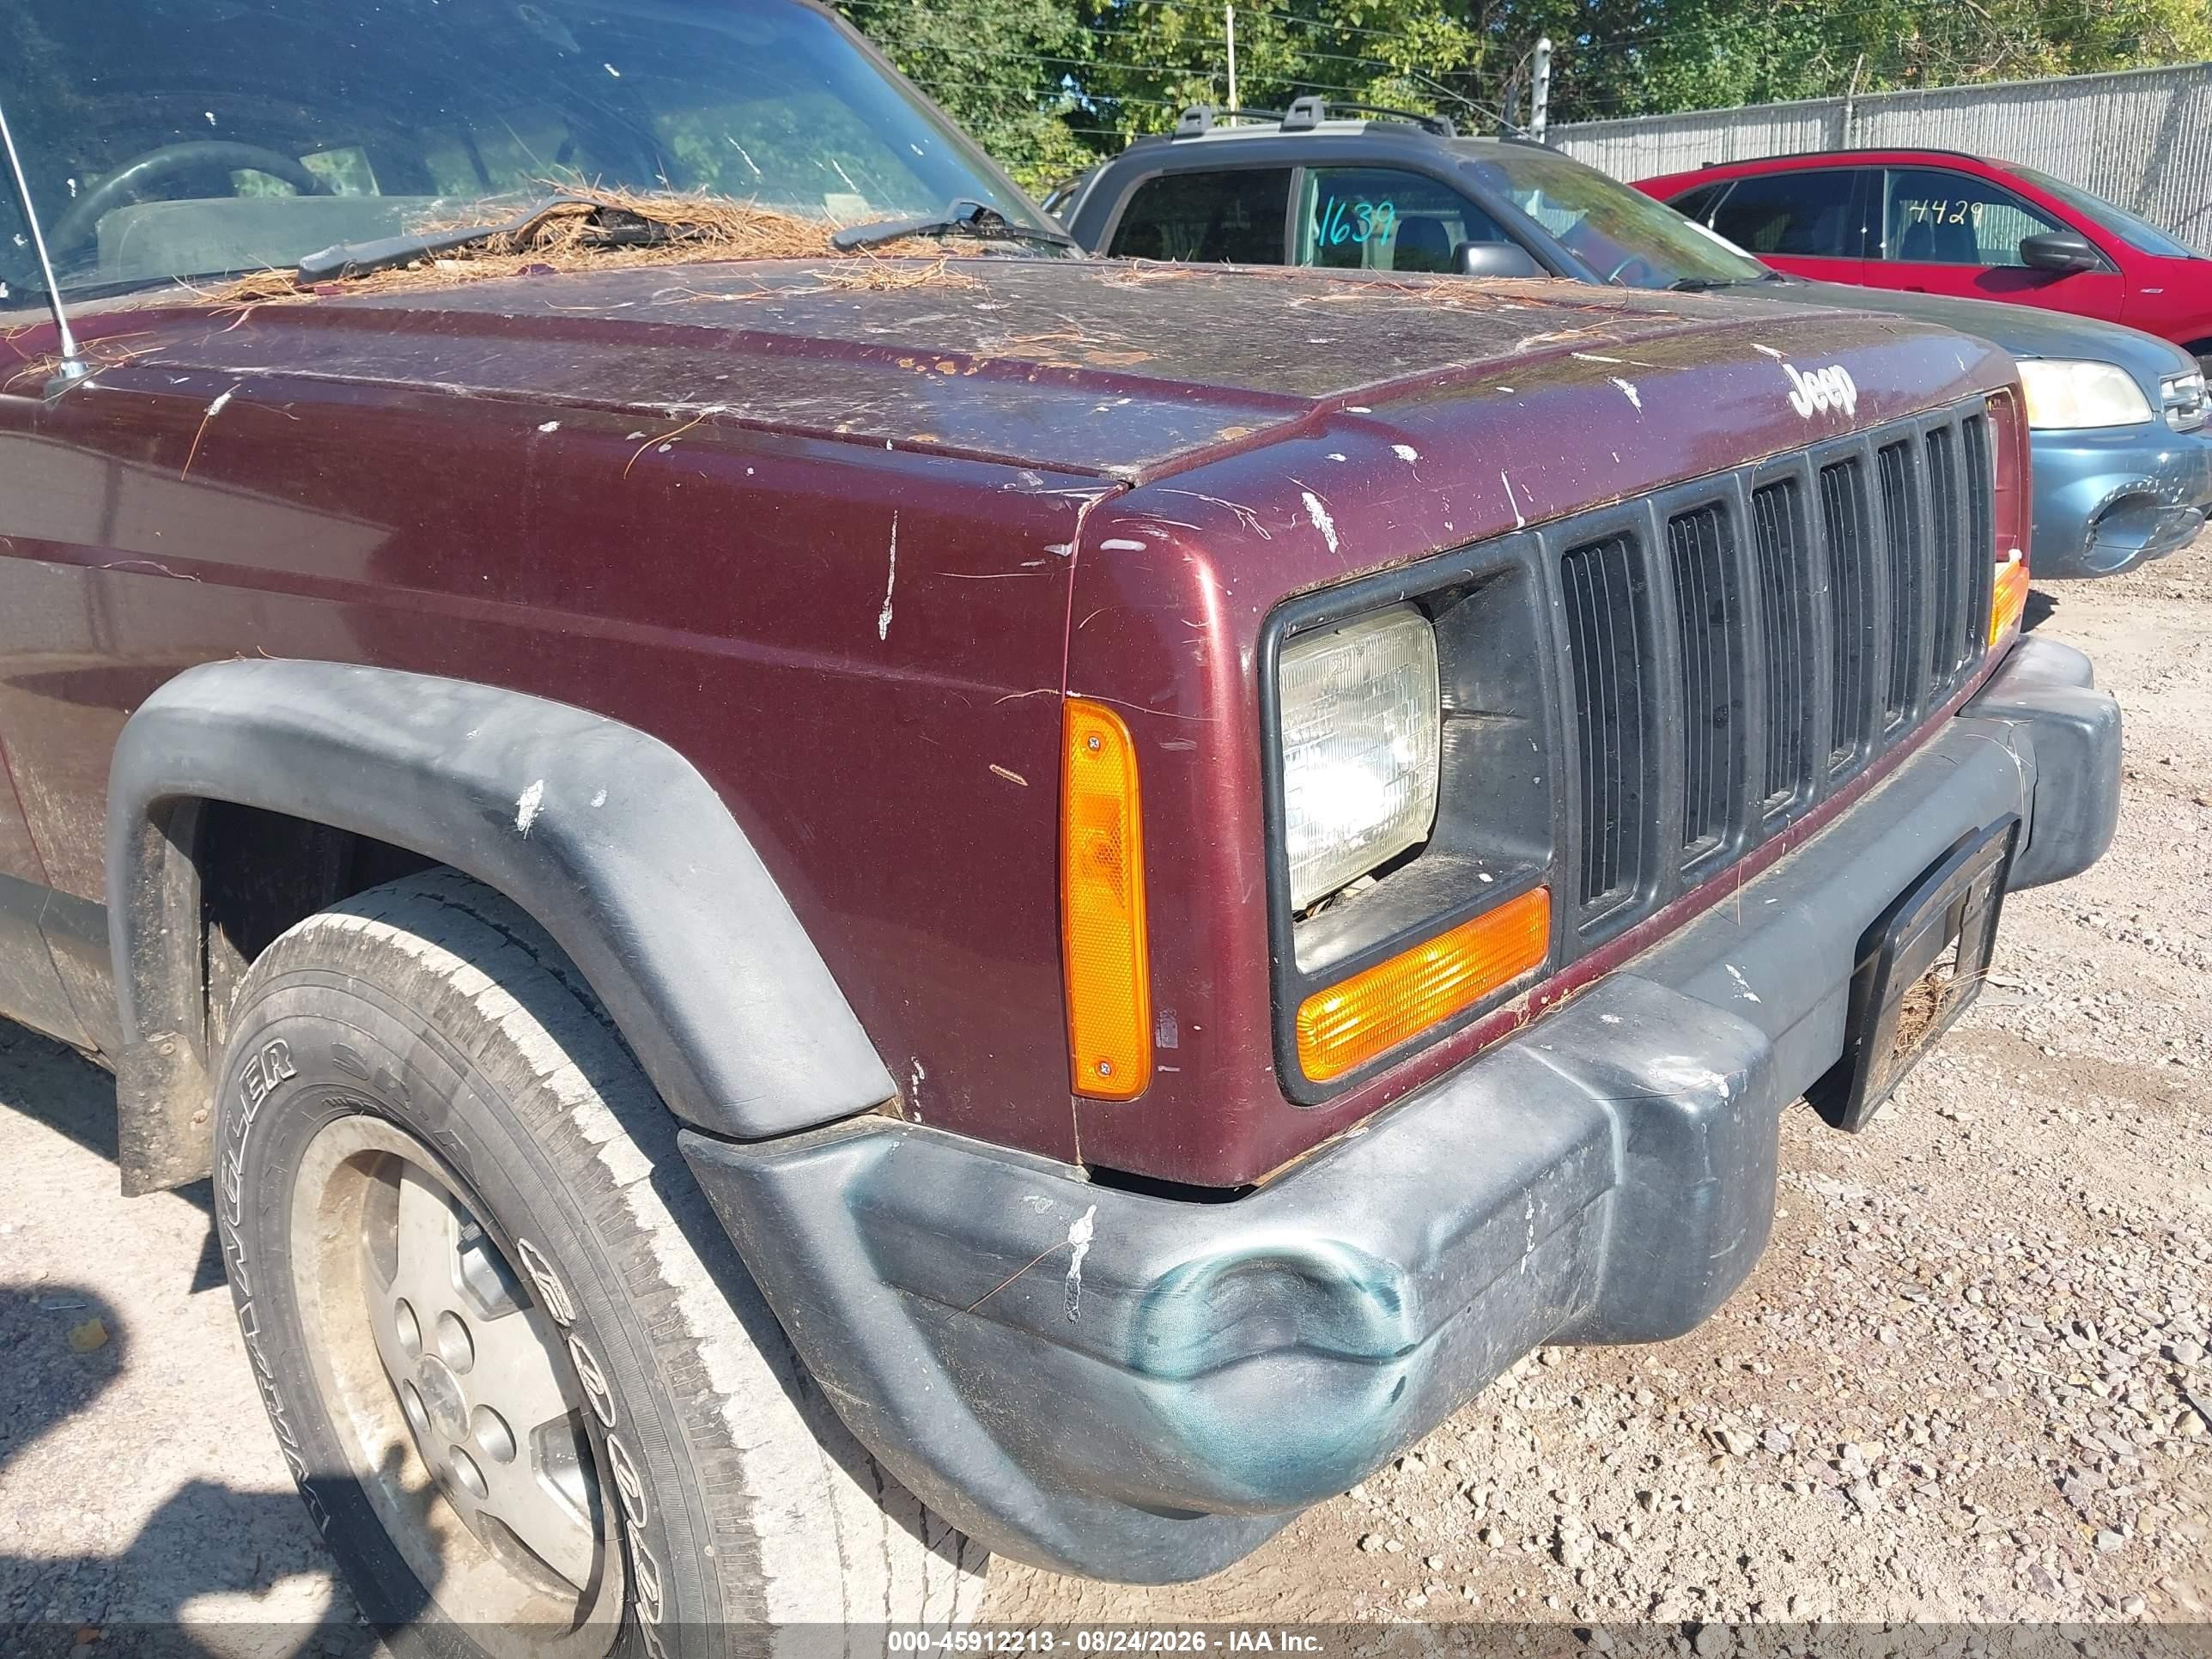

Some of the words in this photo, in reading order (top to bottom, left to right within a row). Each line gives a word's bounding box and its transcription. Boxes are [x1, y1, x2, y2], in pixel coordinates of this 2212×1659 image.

[1319, 194, 1395, 246] 1639
[1909, 199, 1983, 228] 4429
[1782, 363, 1857, 419] Jeep
